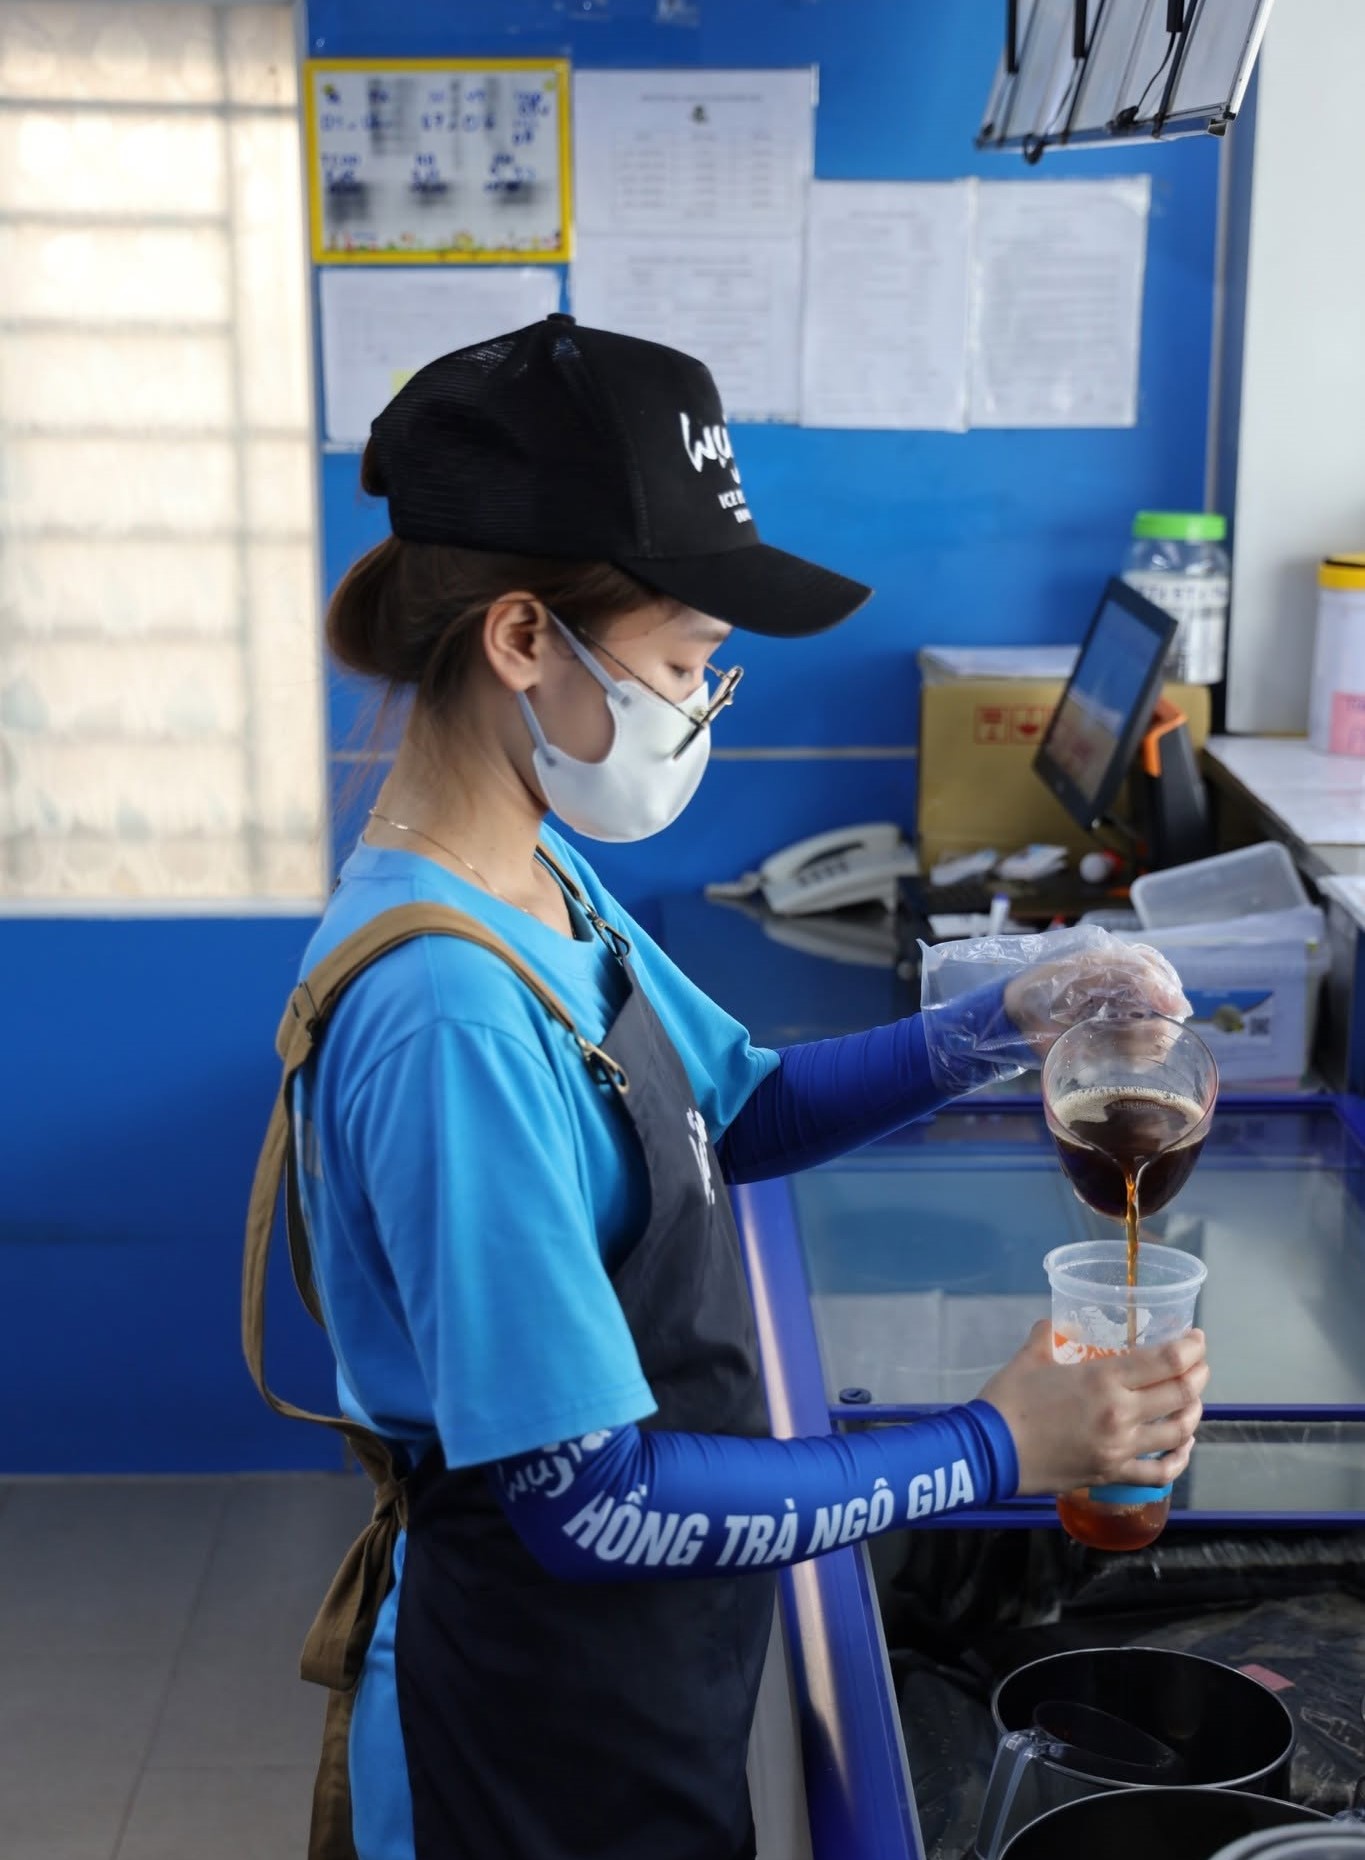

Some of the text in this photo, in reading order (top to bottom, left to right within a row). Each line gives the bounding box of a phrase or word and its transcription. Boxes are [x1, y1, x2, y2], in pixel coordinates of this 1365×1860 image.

[562, 1459, 975, 1567] HỒNG TRÀ NGÔ GIA
